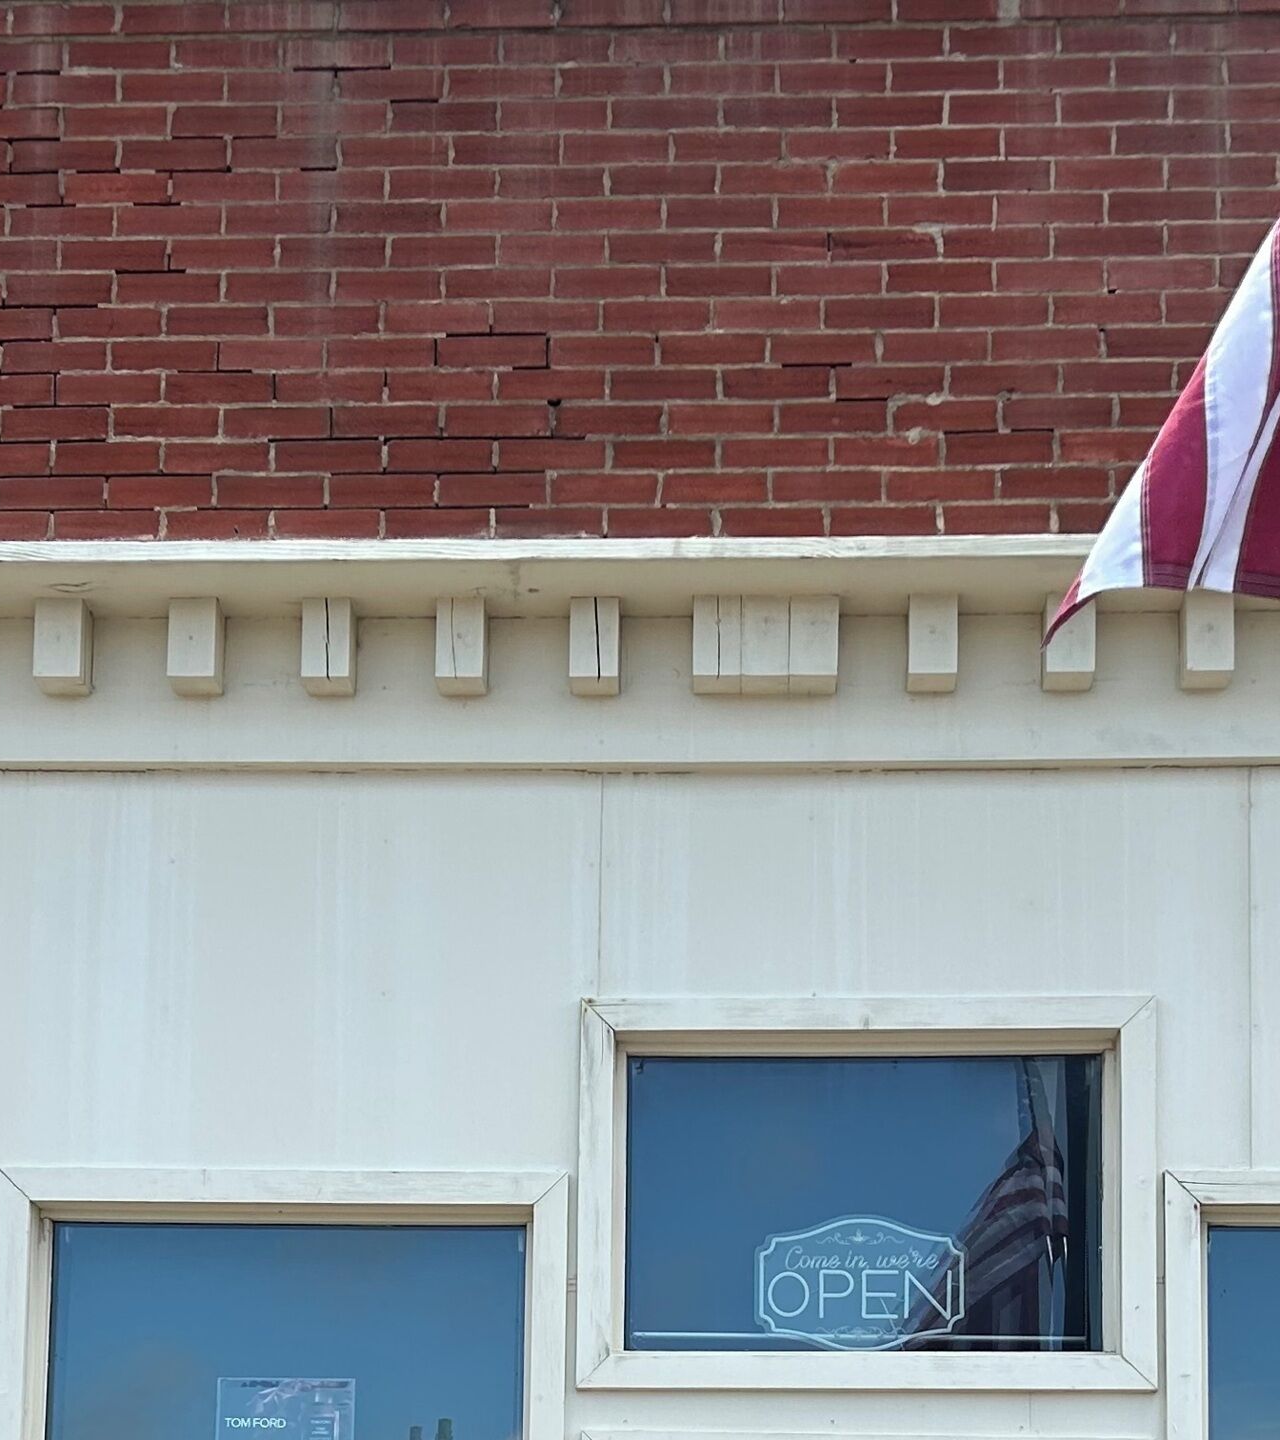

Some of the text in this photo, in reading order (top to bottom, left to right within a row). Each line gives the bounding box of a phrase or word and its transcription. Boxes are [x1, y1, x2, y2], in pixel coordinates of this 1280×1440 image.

[785, 1245, 841, 1270] Come
[767, 1270, 952, 1320] OPEN
[224, 1417, 286, 1428] TOM FORD
